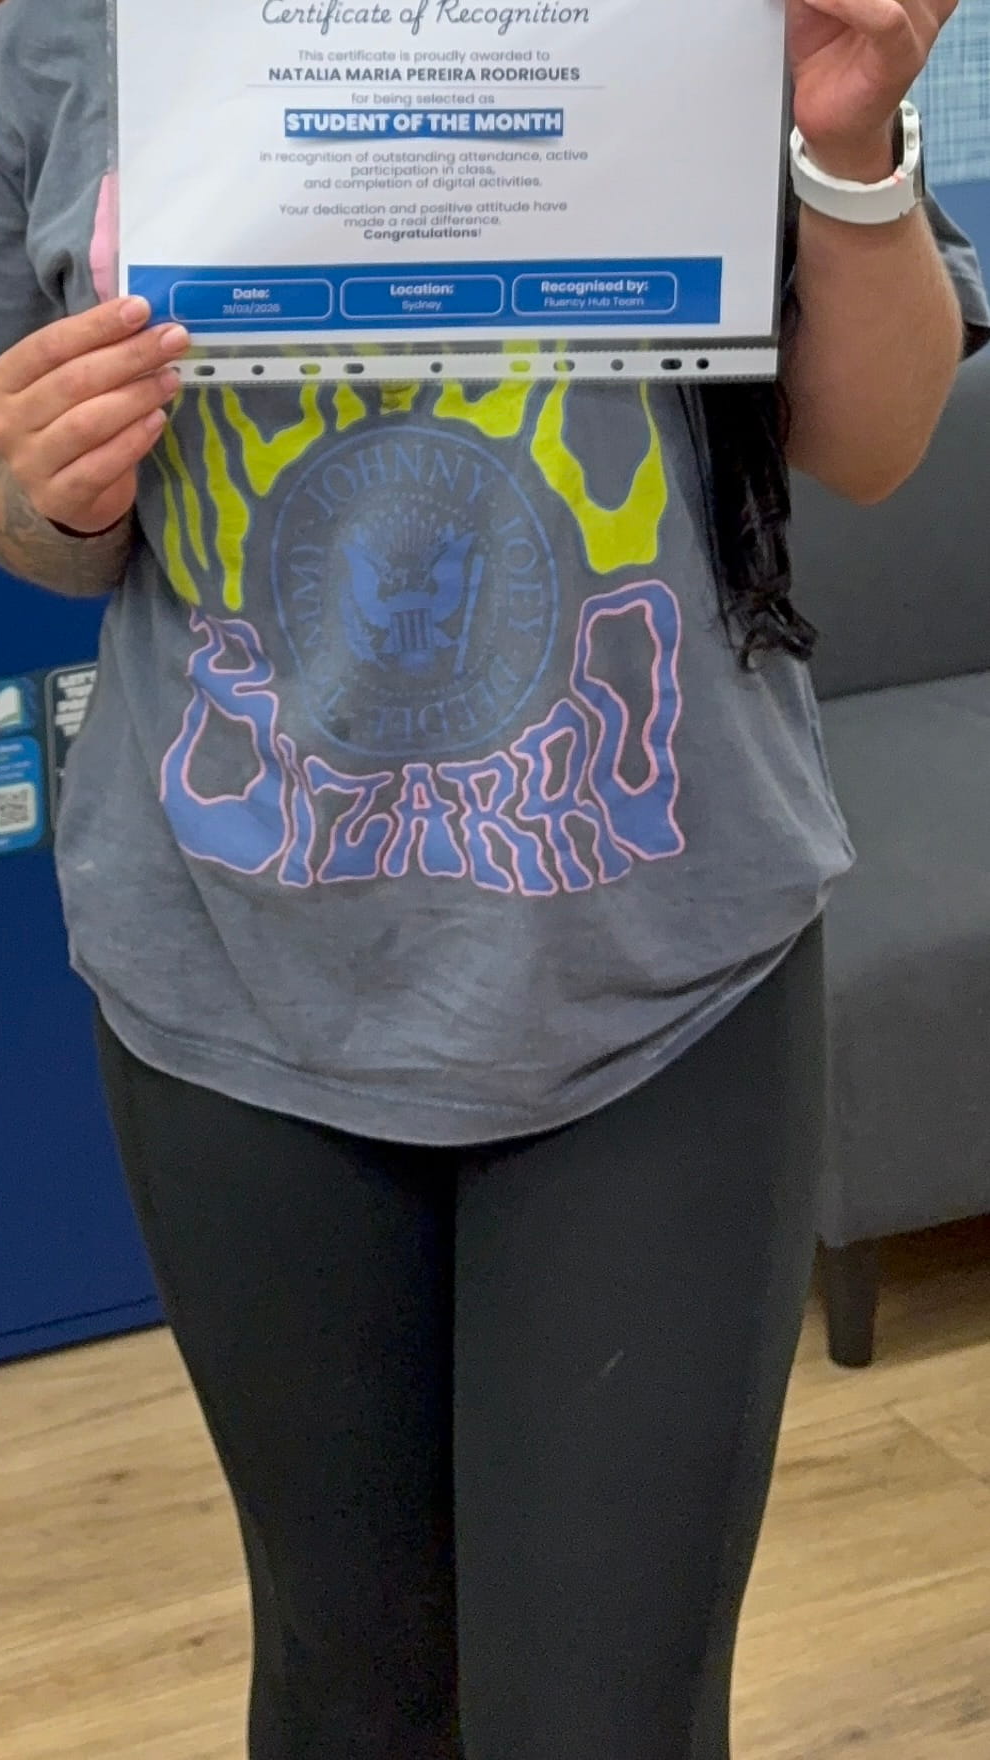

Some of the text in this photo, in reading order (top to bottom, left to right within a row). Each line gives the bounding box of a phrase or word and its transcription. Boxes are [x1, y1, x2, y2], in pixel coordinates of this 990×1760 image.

[298, 49, 550, 64] This certificate is proudly awarded to
[268, 67, 580, 81] NATALIA MARIA PEREIRA RODRIGUES
[351, 92, 495, 107] for being selected as
[286, 113, 561, 132] STUDENT OF THE MONTH
[275, 151, 352, 166] recognition
[355, 151, 369, 163] of
[372, 151, 455, 166] outstanding
[459, 150, 542, 163] attendance,
[545, 149, 588, 161] active
[350, 164, 496, 178] participation in class,
[304, 176, 542, 191] and completion of digital activities.
[278, 200, 568, 216] Your dedication and positive attitude have
[343, 215, 502, 228] made a real difference.
[363, 227, 482, 242] Congratulations!
[232, 287, 270, 300] Date:
[390, 283, 454, 296] Location:
[541, 280, 649, 296] Recognised by:
[401, 299, 442, 311] Sydney
[544, 296, 645, 309] Fluency Hub Team
[307, 441, 497, 522] JOHNNY
[495, 515, 564, 633] JOEY
